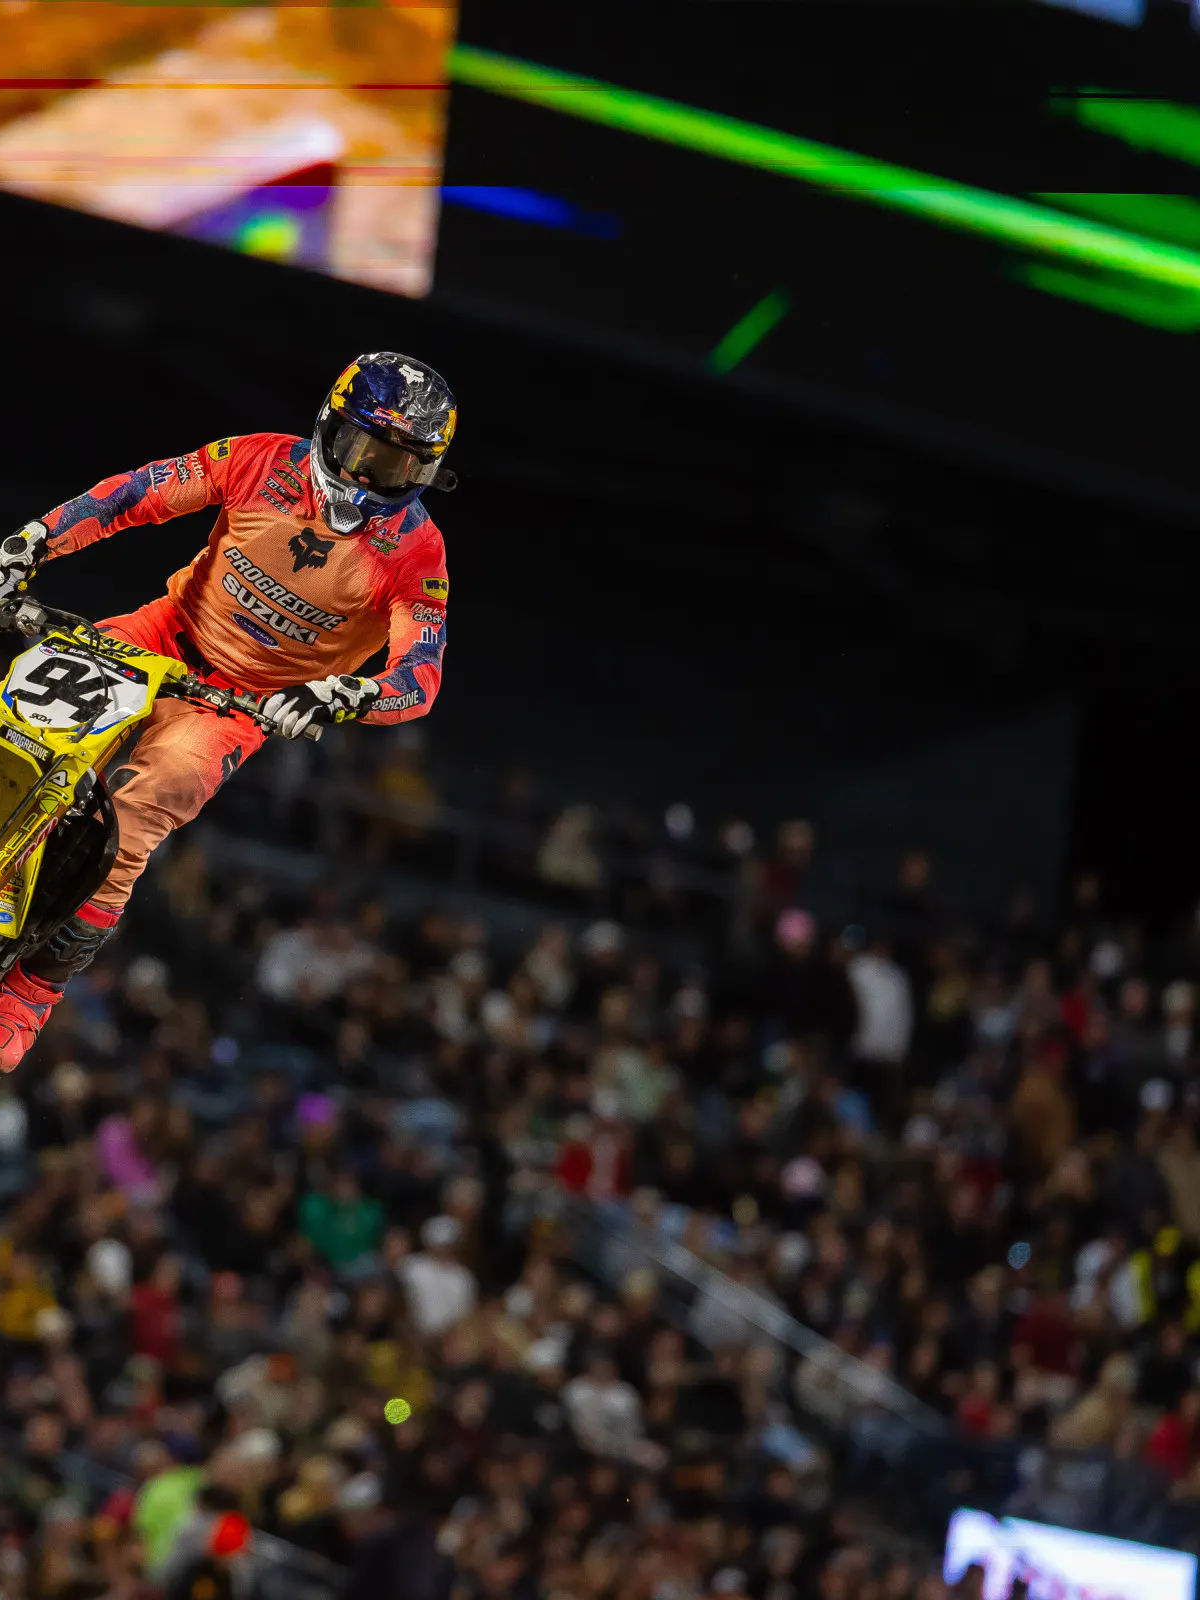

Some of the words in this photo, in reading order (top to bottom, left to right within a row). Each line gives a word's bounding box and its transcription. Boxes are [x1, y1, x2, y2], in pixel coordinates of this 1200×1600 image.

[222, 572, 320, 646] SUZUKI
[223, 546, 348, 631] PROGRESSIVE
[68, 647, 118, 669] SUPEROSS
[7, 656, 125, 724] 94
[205, 693, 227, 707] ASV
[5, 728, 49, 762] PROGRESSIVE
